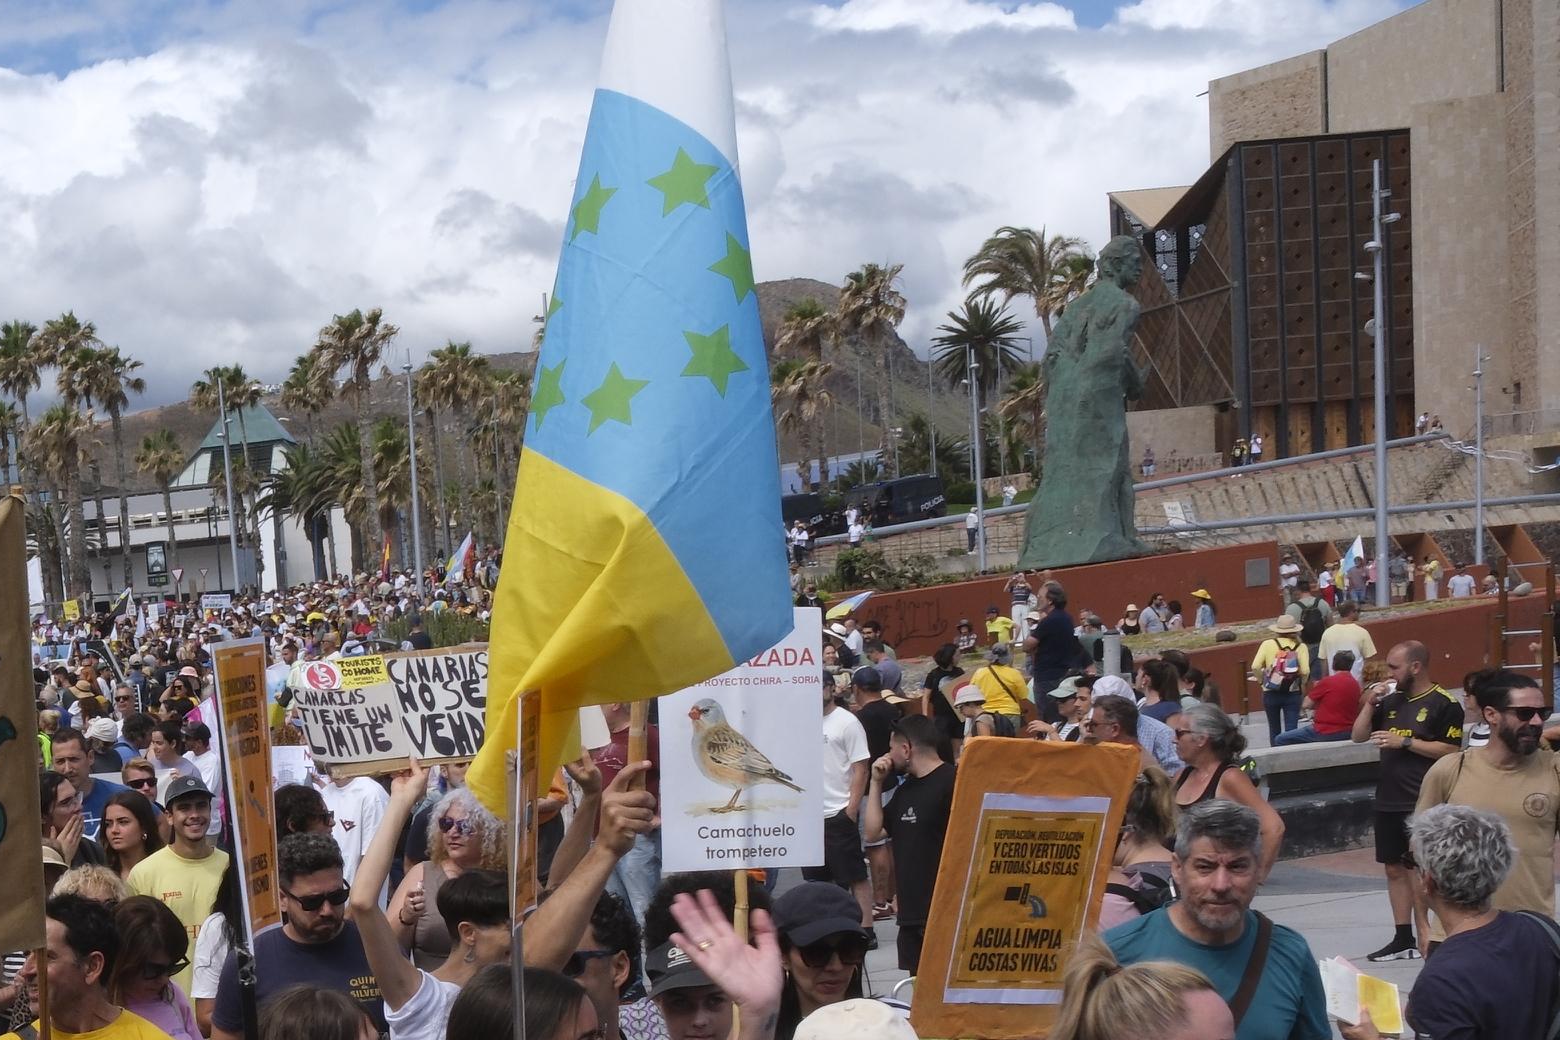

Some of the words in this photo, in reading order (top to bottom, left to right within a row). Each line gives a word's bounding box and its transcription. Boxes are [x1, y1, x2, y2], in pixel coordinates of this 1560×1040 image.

[336, 656, 382, 668] TOURISTS
[354, 666, 382, 677] HOME
[386, 651, 489, 685] CANARIAS
[752, 676, 782, 686] CHIRA
[791, 675, 821, 685] SORIA
[442, 678, 488, 711] SE
[297, 706, 360, 726] TIENE
[365, 702, 394, 725] UN
[303, 722, 393, 758] LIMITE
[401, 710, 487, 757] VEND
[697, 823, 796, 840] Camachuelo
[706, 844, 788, 861] trompetero
[993, 842, 1000, 858] Y
[1000, 842, 1028, 859] CERO
[1029, 843, 1082, 860] VERTIDOS
[988, 860, 1002, 874] EN
[1002, 860, 1031, 875] TODAS
[1031, 861, 1052, 875] LAS
[1051, 861, 1079, 876] ISLAS
[973, 927, 1013, 949] AGUA
[1012, 927, 1062, 950] LIMPIA
[968, 952, 1019, 972] COSTAS
[1019, 953, 1058, 973] VIVAS
